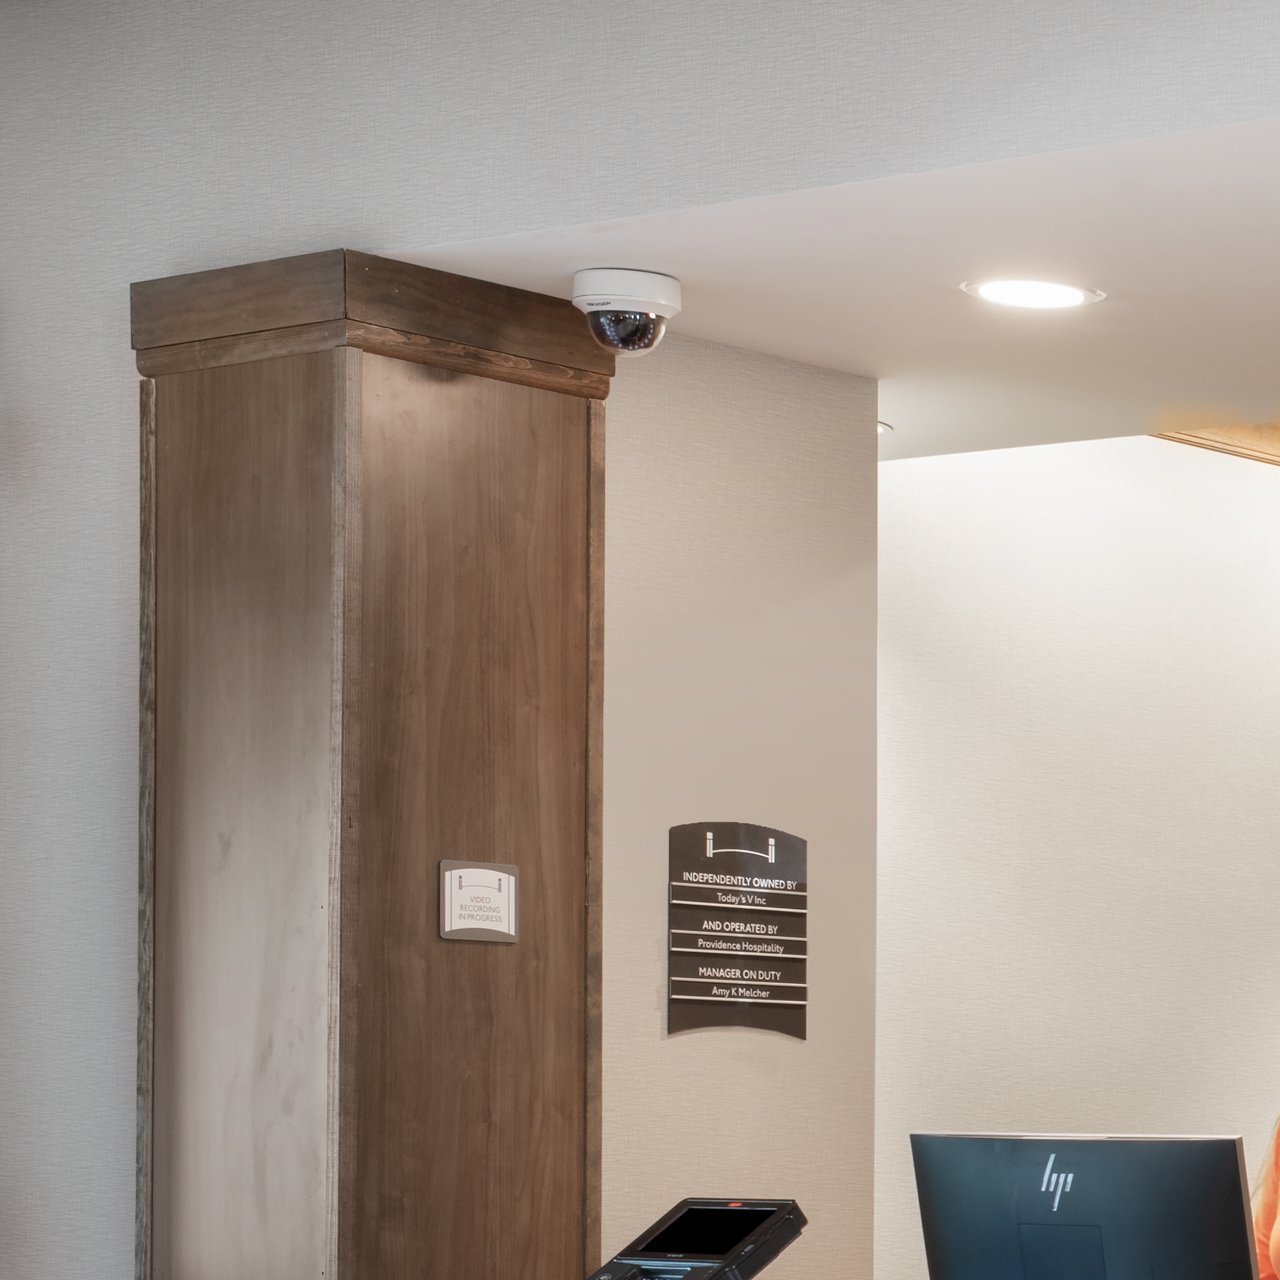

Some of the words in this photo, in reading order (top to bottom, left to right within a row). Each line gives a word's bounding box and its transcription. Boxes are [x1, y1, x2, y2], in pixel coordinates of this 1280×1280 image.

[683, 871, 752, 886] INDEPENDENTLY
[752, 877, 786, 889] OWNED
[786, 880, 797, 891] BY
[469, 896, 491, 904] VIDEO
[717, 892, 746, 905] Today's
[746, 895, 754, 903] V
[755, 895, 767, 905] Inc
[460, 904, 501, 913] RECORDING
[467, 914, 503, 923] PROGRESS
[702, 920, 722, 931] AND
[723, 921, 767, 934] OPERATED
[767, 925, 778, 935] BY
[698, 938, 741, 950] Providence
[742, 941, 784, 955] Hospitality
[698, 967, 741, 979] MANAGER
[742, 969, 757, 979] ON
[758, 970, 782, 981] DUTY
[712, 986, 730, 998] Amy
[731, 987, 738, 996] K
[738, 987, 770, 998] Melcher
[1041, 1153, 1074, 1212] hp
